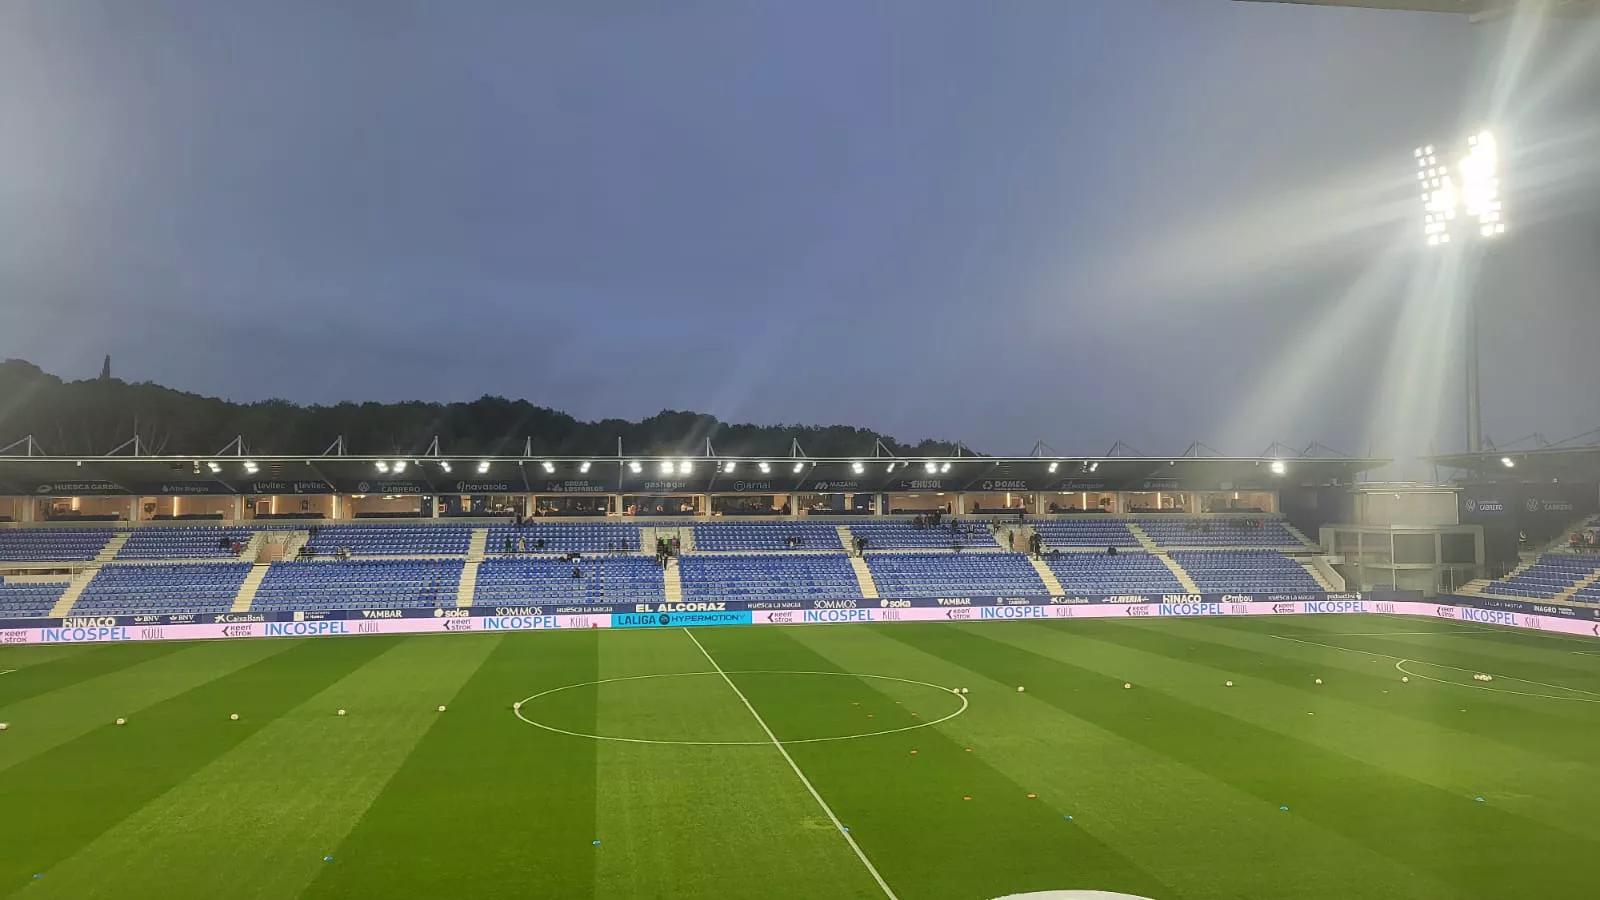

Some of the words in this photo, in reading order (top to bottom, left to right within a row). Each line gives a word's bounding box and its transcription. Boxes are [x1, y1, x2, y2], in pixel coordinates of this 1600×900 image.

[635, 603, 653, 613] EL
[657, 602, 726, 612] ALCORAZ
[980, 606, 1049, 618] INCOSPEL
[1158, 603, 1225, 615] INCOSPEL
[1304, 602, 1368, 613] INCOSPEL
[369, 610, 403, 618] AMBAR
[618, 615, 656, 625] LALIGA
[670, 614, 740, 623] HYPERMOTION
[803, 609, 875, 622] INCOSPEL
[1461, 607, 1518, 625] INCOSPEL
[264, 621, 349, 635] INCOSPEL
[483, 615, 561, 629] INCOSPEL
[40, 627, 131, 641] INCOSPEL
